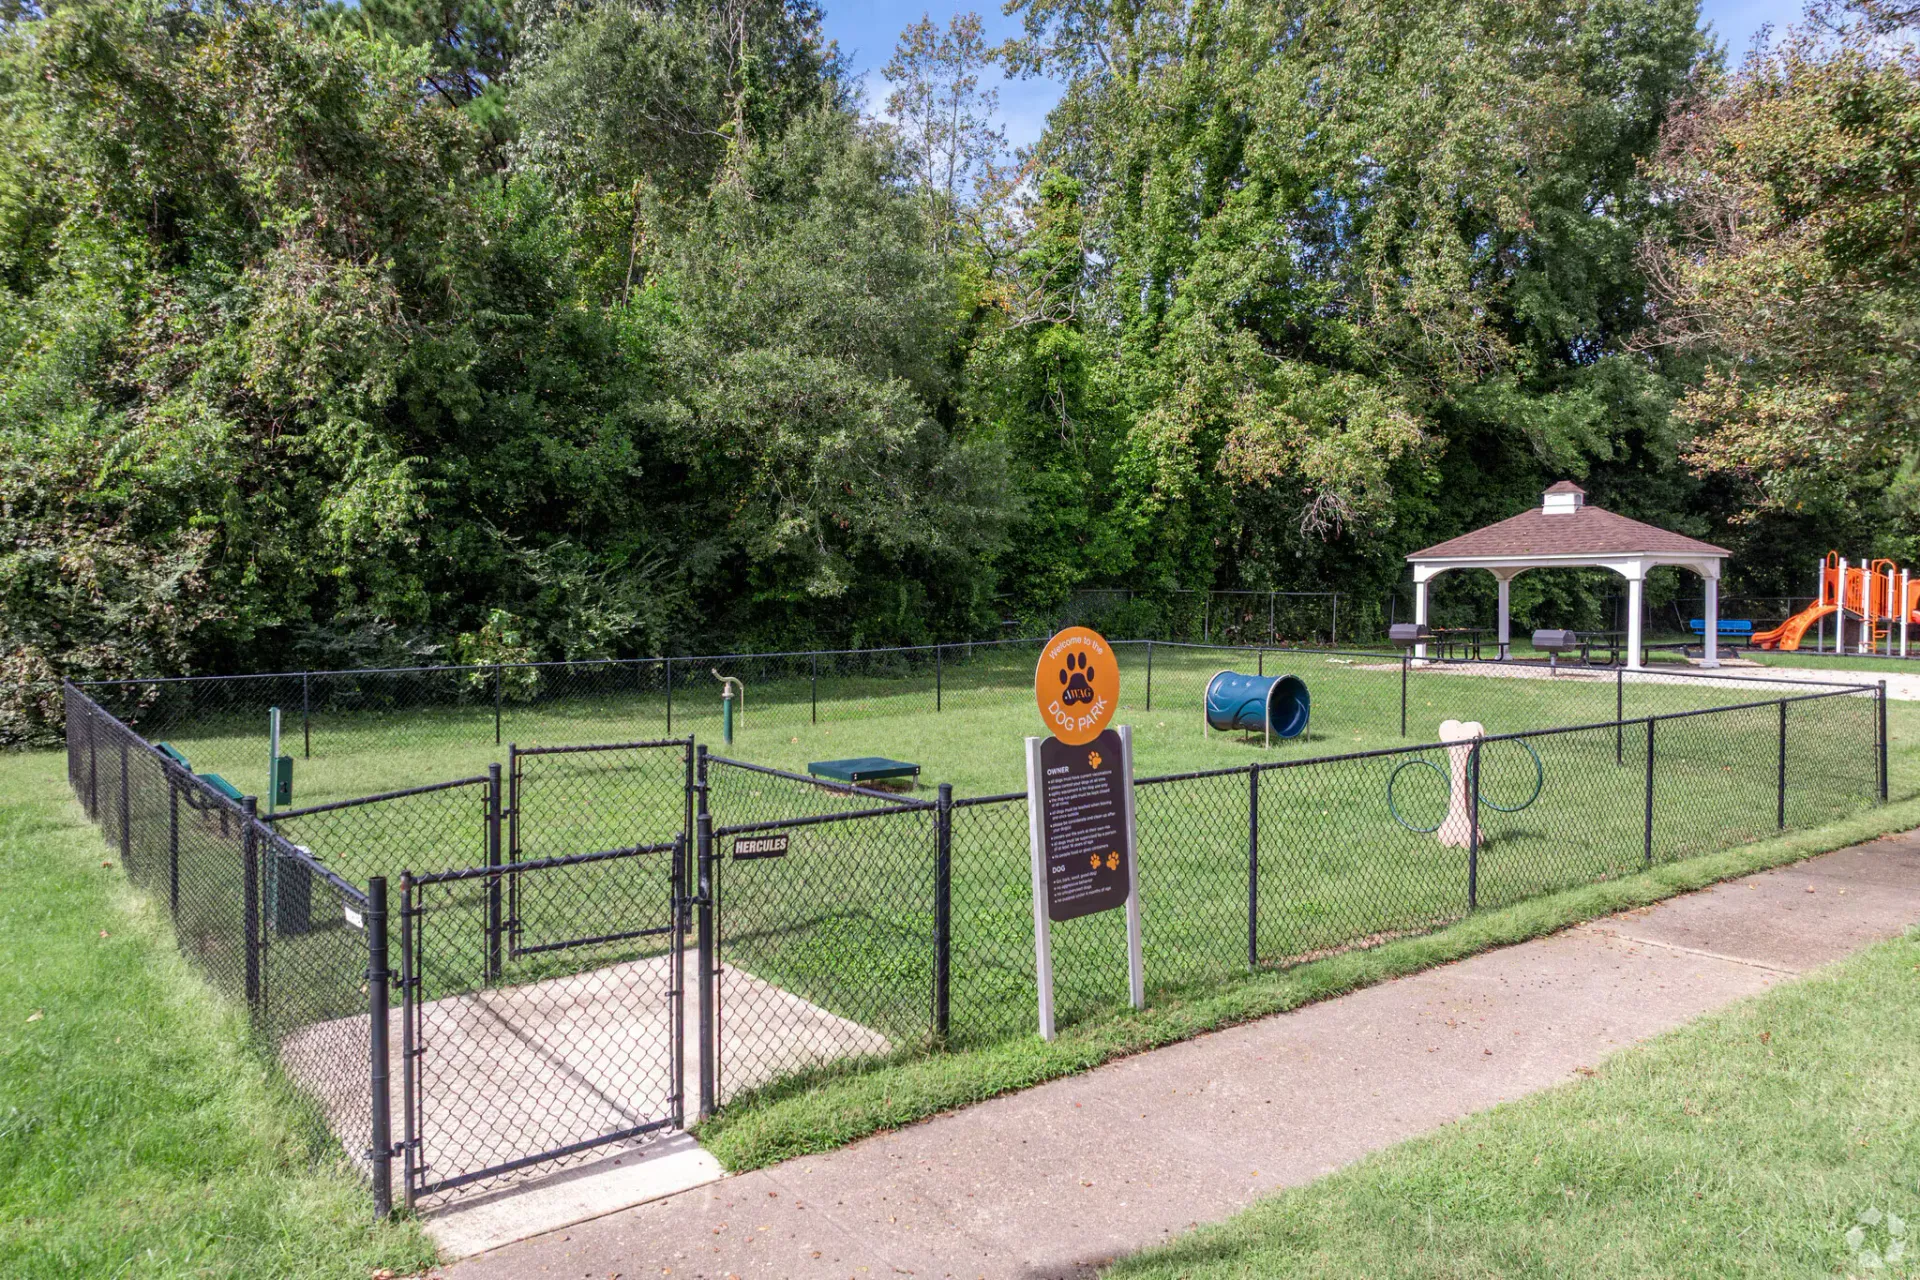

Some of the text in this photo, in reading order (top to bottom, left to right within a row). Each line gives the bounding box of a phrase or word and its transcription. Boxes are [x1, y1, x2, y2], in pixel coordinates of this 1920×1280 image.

[1049, 636, 1103, 660] Welcome to the
[1048, 696, 1107, 732] DOG PARK
[1047, 766, 1069, 775] OWNER
[736, 838, 786, 854] HERCULES
[1052, 864, 1065, 874] DOG
